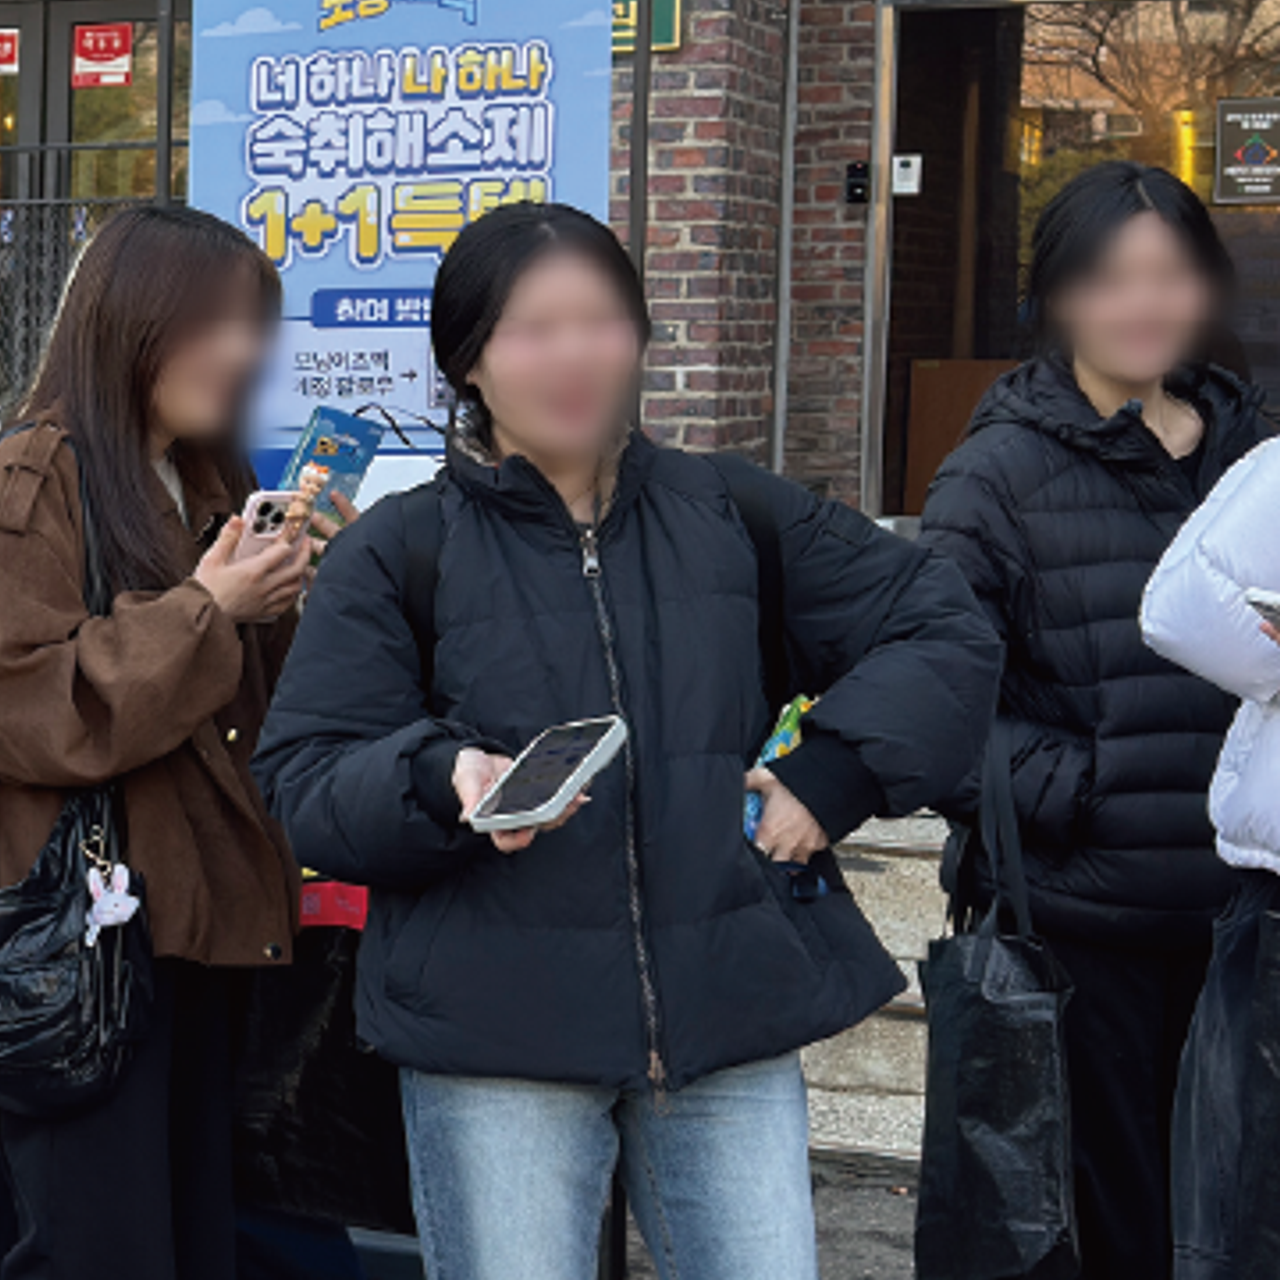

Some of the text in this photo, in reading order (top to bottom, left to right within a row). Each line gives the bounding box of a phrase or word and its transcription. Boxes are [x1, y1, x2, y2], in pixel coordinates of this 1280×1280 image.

[251, 42, 548, 111] 너 하나 나 하나
[250, 105, 549, 178] 숙취해소제
[244, 183, 382, 266] 1+1
